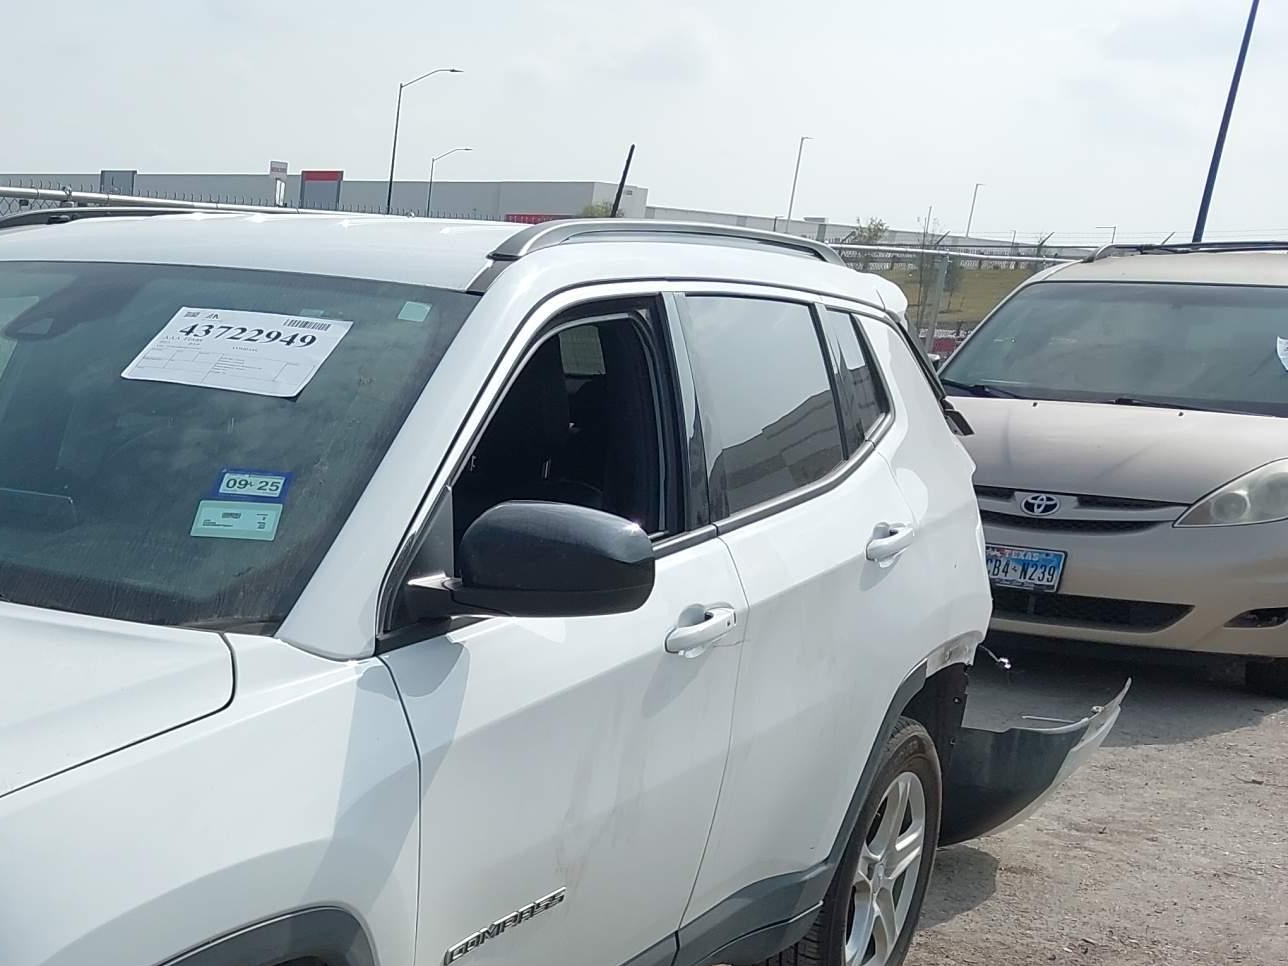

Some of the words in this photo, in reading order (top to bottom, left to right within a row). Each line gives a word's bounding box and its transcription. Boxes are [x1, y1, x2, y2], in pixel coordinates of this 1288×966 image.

[178, 323, 317, 348] 43722949
[226, 478, 249, 490] 09
[257, 480, 281, 492] 25
[1005, 548, 1040, 561] TEXAS
[443, 886, 567, 966] COMPASS
